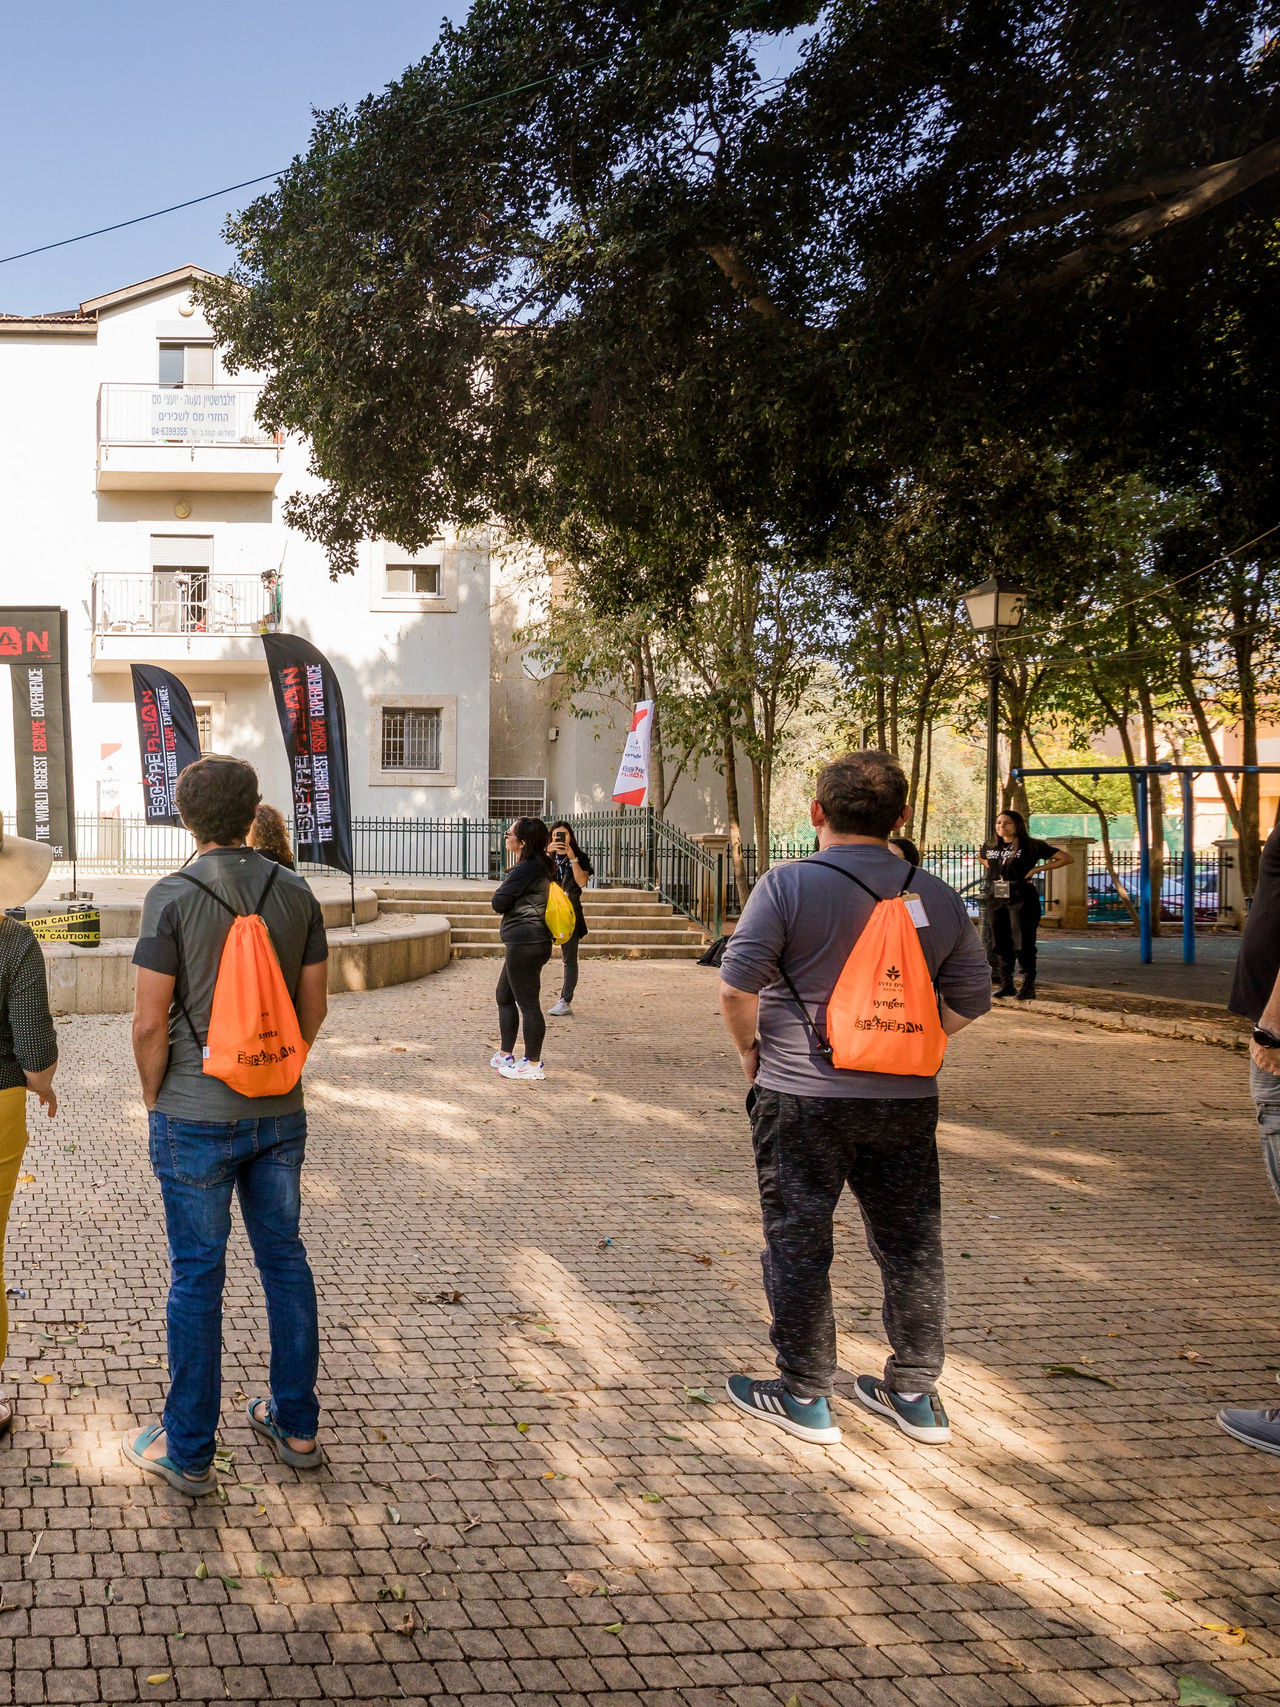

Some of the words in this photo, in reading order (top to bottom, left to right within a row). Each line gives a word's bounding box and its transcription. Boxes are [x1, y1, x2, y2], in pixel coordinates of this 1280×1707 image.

[158, 410, 189, 421] לשכירים
[192, 412, 204, 421] מס
[207, 413, 228, 422] החזרי
[28, 668, 45, 717] EXPERIENCE
[159, 687, 173, 725] EXPERIENCE
[306, 664, 325, 717] EXPERIENCE
[31, 720, 47, 752] ESCAPE
[164, 726, 176, 751] ESCAPE
[310, 718, 327, 753] ESCAPE
[33, 756, 48, 790] BIGGEST
[166, 752, 178, 777] BIGGEST
[312, 755, 330, 791] BIGGEST
[34, 792, 49, 823] WORLD
[315, 792, 331, 825] WORLD
[36, 824, 50, 841] THE
[317, 826, 332, 842] THE
[26, 919, 47, 927] TION
[51, 912, 91, 924] CAUTION
